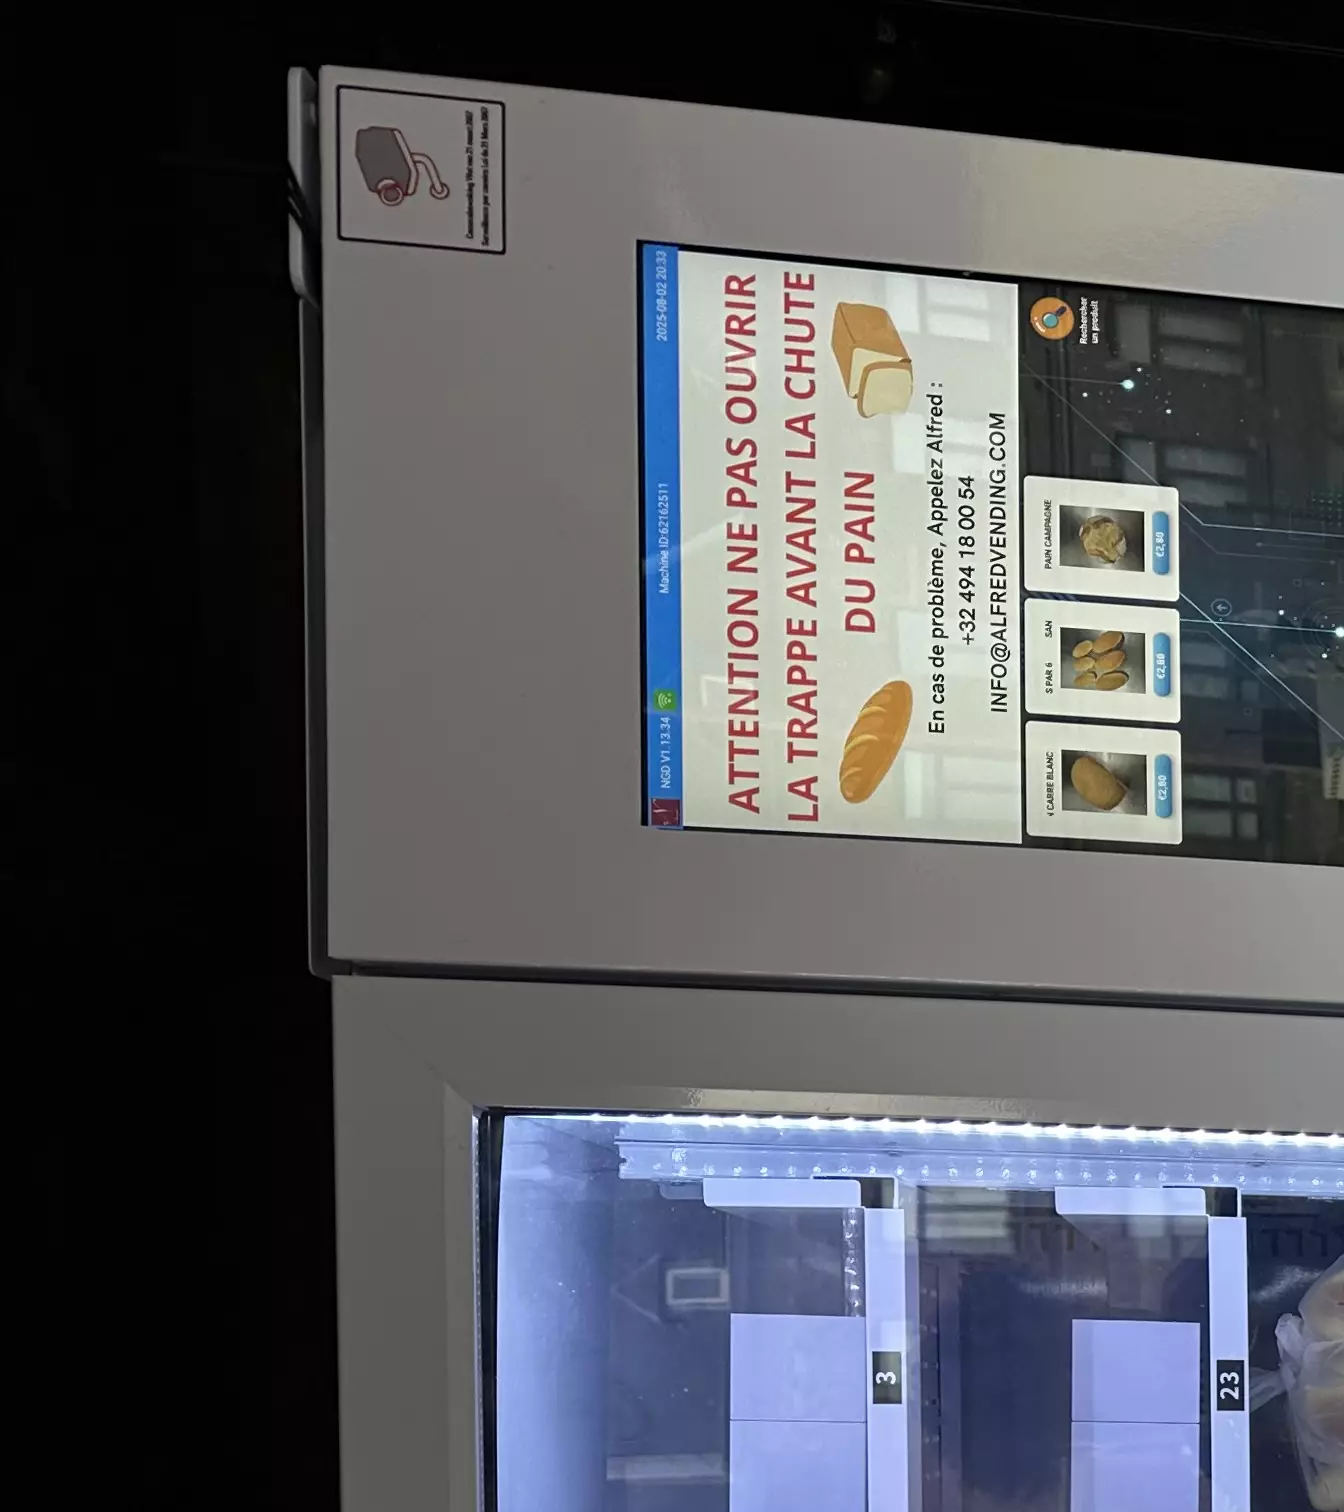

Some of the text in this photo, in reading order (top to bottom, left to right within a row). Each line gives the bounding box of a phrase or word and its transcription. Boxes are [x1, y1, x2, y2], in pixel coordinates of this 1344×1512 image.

[656, 282, 668, 342] 2025-08-02
[1079, 297, 1088, 345] Rechercher
[1090, 300, 1100, 344] un produit
[926, 394, 944, 453] Alfred
[927, 458, 948, 537] Appelez
[658, 483, 670, 594] Machine ID:62162511
[724, 274, 760, 815] ATTENTION NE PAS OUVRIR
[783, 270, 819, 822] LA TRAPPE AVANT LA CHUTE
[844, 471, 876, 634] DU PAIN
[957, 475, 976, 646] +32 494 18 00 54
[988, 412, 1009, 713] INFO@ALFREDVENDING.COM
[1043, 499, 1052, 570] PAIN CAMPAGNE
[927, 541, 949, 639] problème,
[928, 644, 945, 668] de
[1045, 669, 1053, 687] PAR
[932, 673, 945, 705] cas
[929, 710, 945, 734] En
[660, 716, 671, 789] NGD V1.13.34
[1045, 751, 1054, 781] BLANC
[1046, 782, 1055, 811] CARRE
[876, 1372, 896, 1384] 3
[1220, 1372, 1239, 1399] 23
